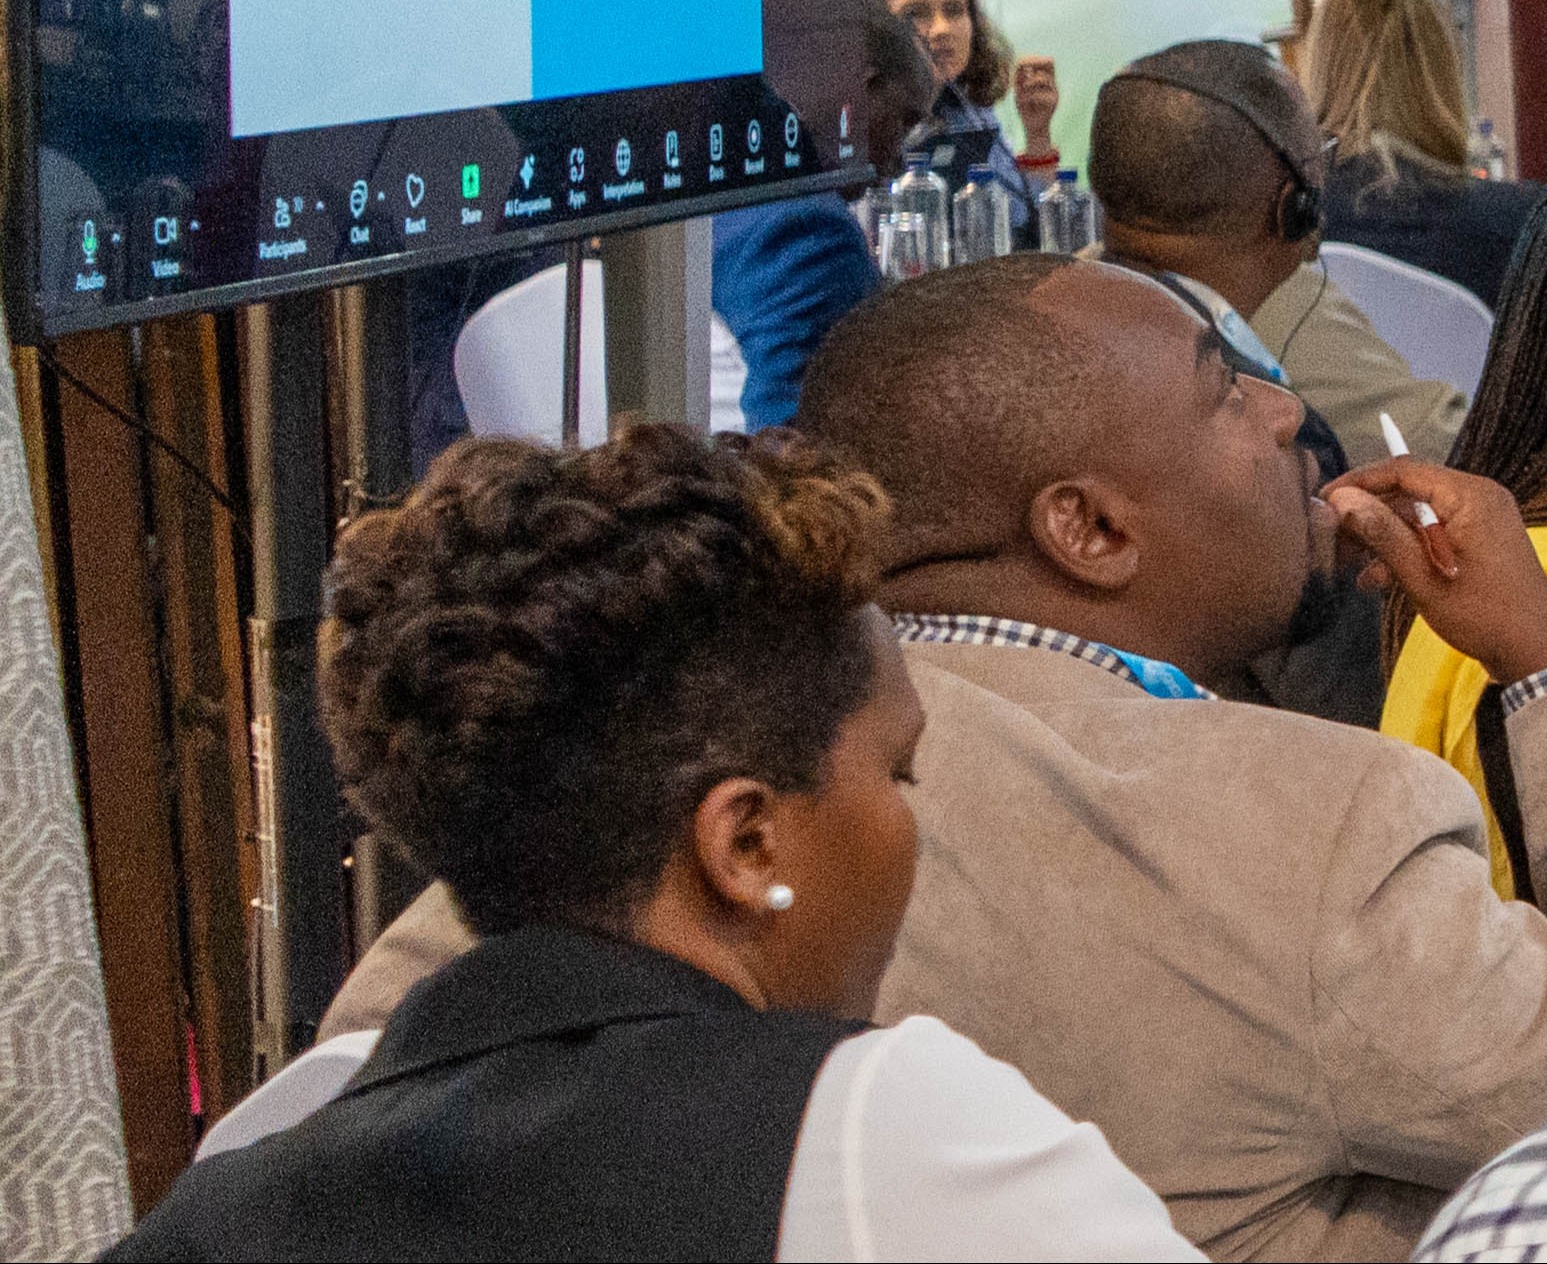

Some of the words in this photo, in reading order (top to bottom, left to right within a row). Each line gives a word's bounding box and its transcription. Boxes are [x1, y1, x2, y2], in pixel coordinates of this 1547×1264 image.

[259, 239, 307, 261] Participants
[152, 260, 180, 279] Video
[76, 273, 106, 292] Audio
